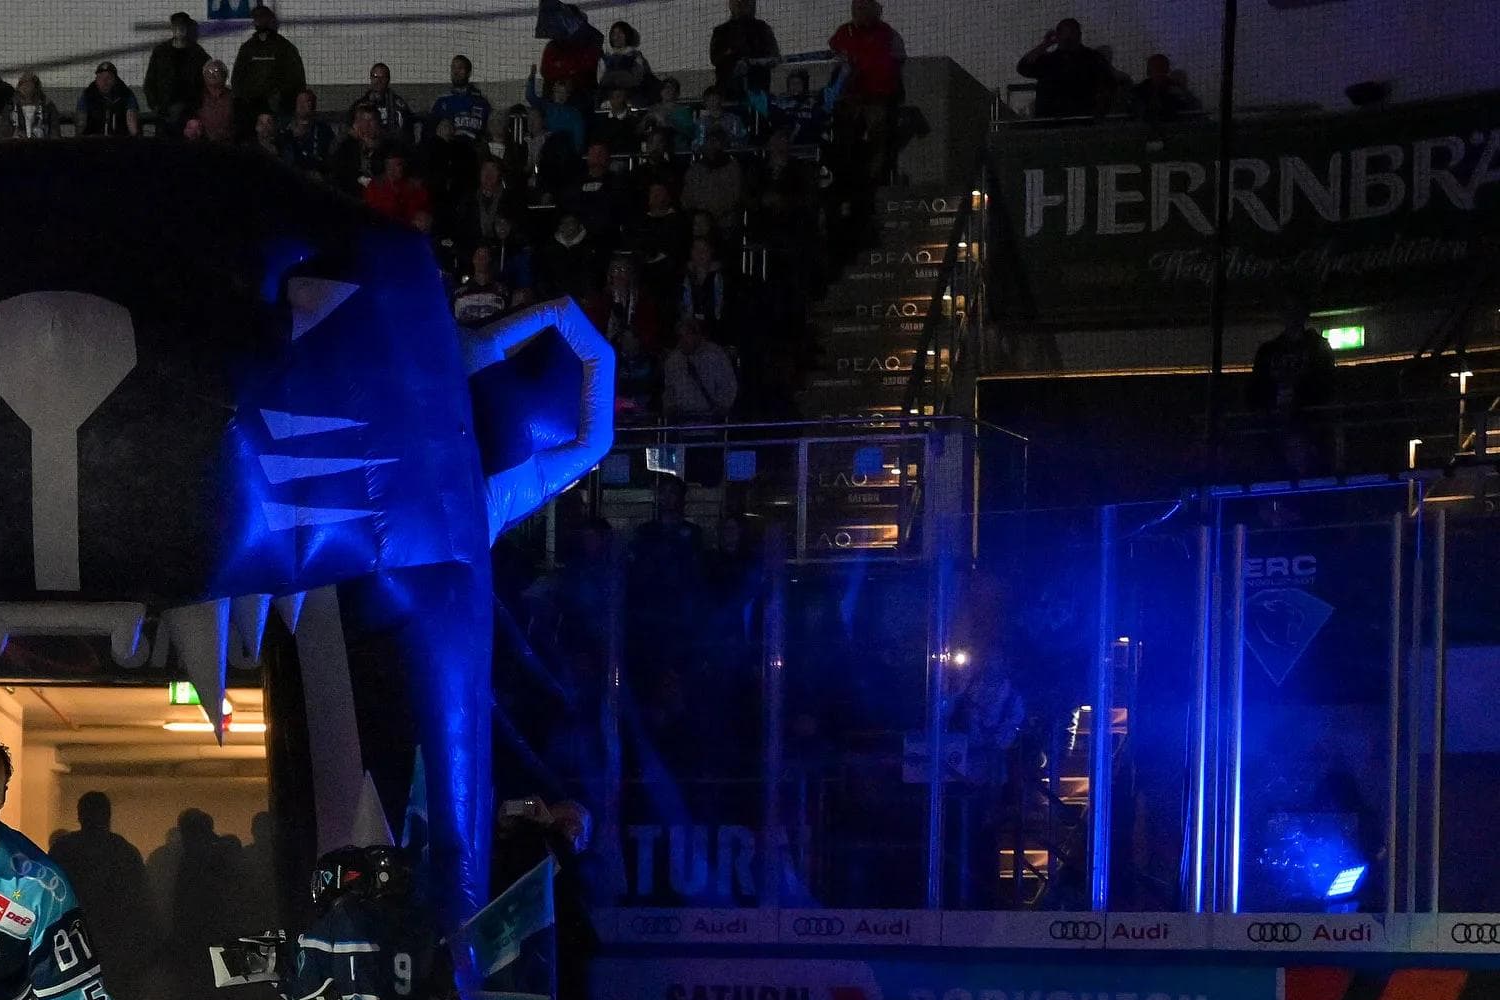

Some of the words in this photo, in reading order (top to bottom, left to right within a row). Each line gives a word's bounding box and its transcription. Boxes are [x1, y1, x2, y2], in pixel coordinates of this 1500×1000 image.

[886, 199, 948, 214] PEAQ
[870, 250, 931, 265] PEAQ
[855, 302, 917, 319] PEAQ
[837, 355, 901, 372] PEAQ
[1244, 556, 1318, 579] ERC
[624, 821, 813, 894] TURN
[694, 913, 748, 931] Audi
[855, 915, 911, 934] Audi
[1113, 920, 1169, 939] Audi
[1313, 921, 1373, 941] Audi
[393, 953, 412, 996] 9
